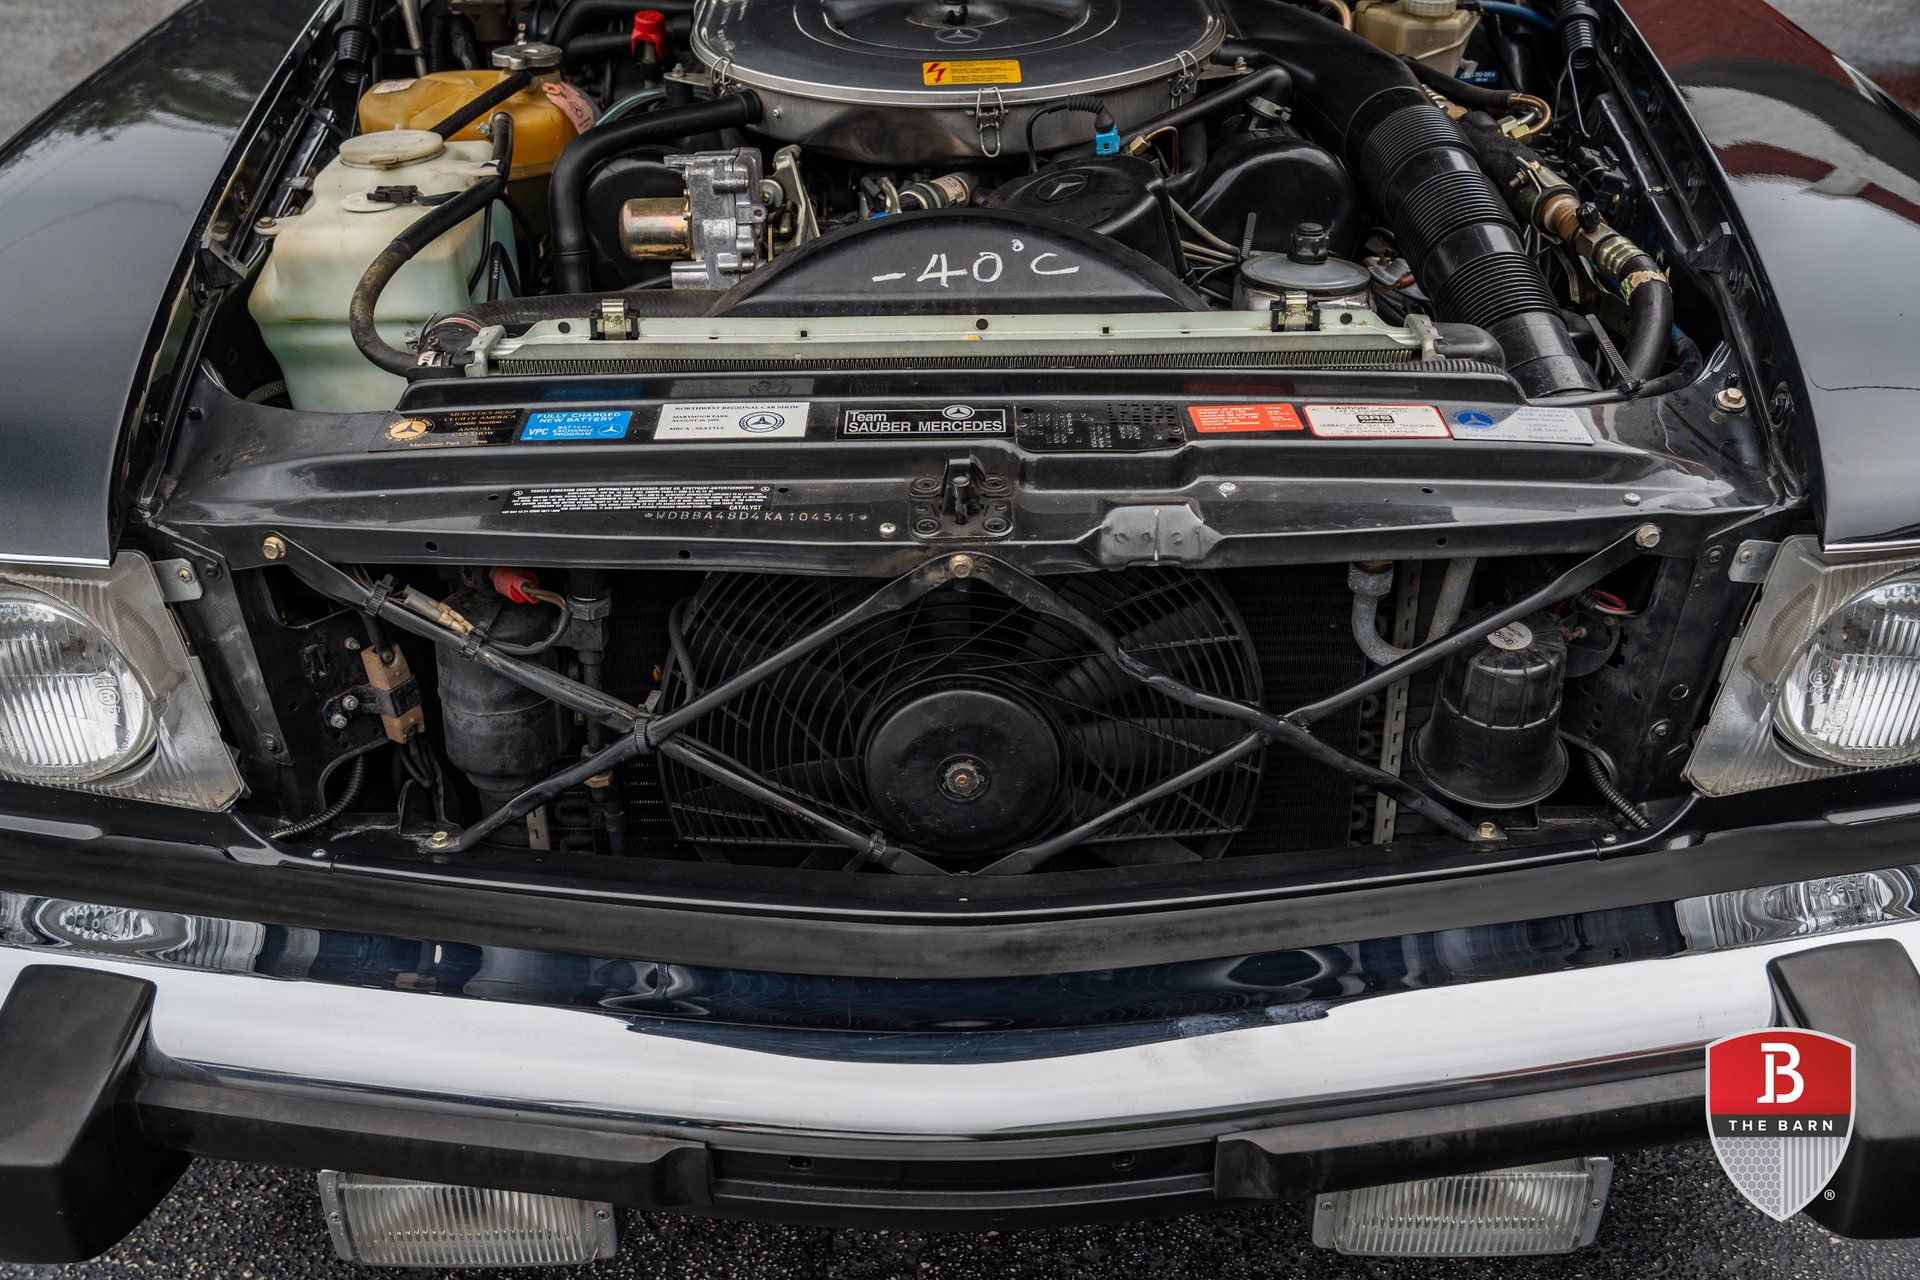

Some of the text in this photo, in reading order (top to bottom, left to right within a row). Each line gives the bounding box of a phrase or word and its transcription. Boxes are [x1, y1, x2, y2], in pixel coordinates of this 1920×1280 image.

[850, 412, 887, 422] Team
[848, 420, 1003, 432] SAUBER MERCEDES
[529, 428, 549, 436] VPC
